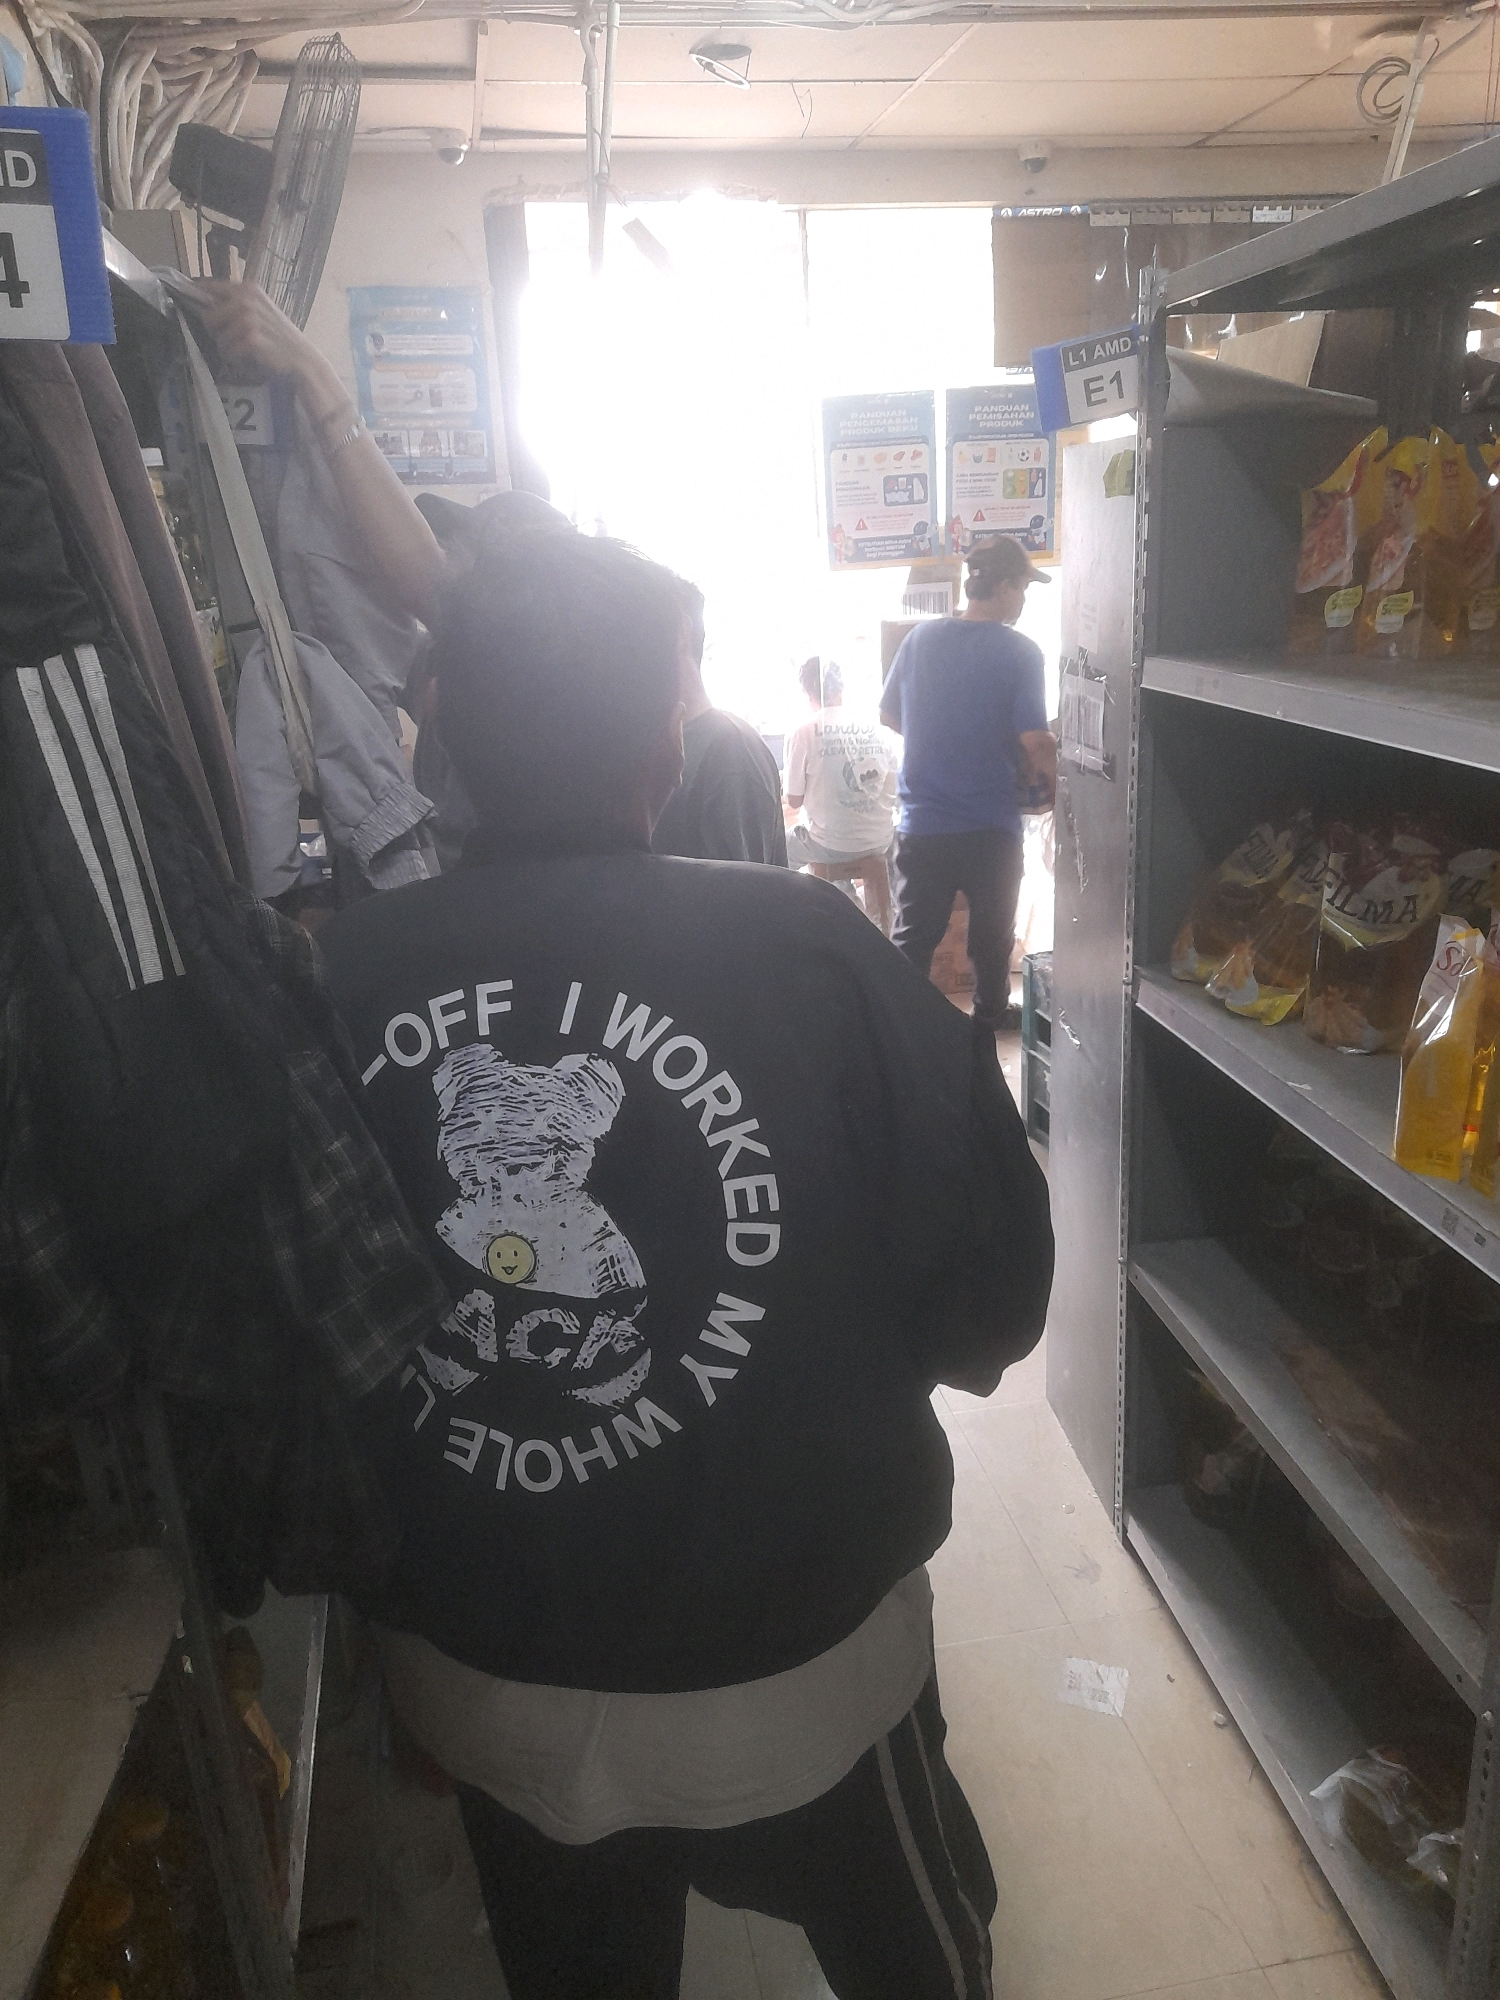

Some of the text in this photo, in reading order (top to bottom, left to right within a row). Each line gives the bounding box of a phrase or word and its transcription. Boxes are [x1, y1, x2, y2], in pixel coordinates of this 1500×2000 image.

[0, 149, 37, 188] D
[1068, 336, 1132, 366] L1 AMD
[1083, 370, 1125, 408] E1
[221, 397, 257, 431] 2
[839, 416, 919, 428] PENGEMASAN
[850, 409, 907, 419] PANDUAN
[968, 411, 1035, 421] PEMISAHAN
[974, 404, 1030, 413] PANDUAN
[979, 419, 1024, 428] PRODUK
[840, 426, 886, 436] PRODUK
[558, 981, 583, 1035] I
[601, 991, 782, 1268] WORKED
[679, 1292, 767, 1407] MY
[442, 1396, 683, 1493] WHOLE
